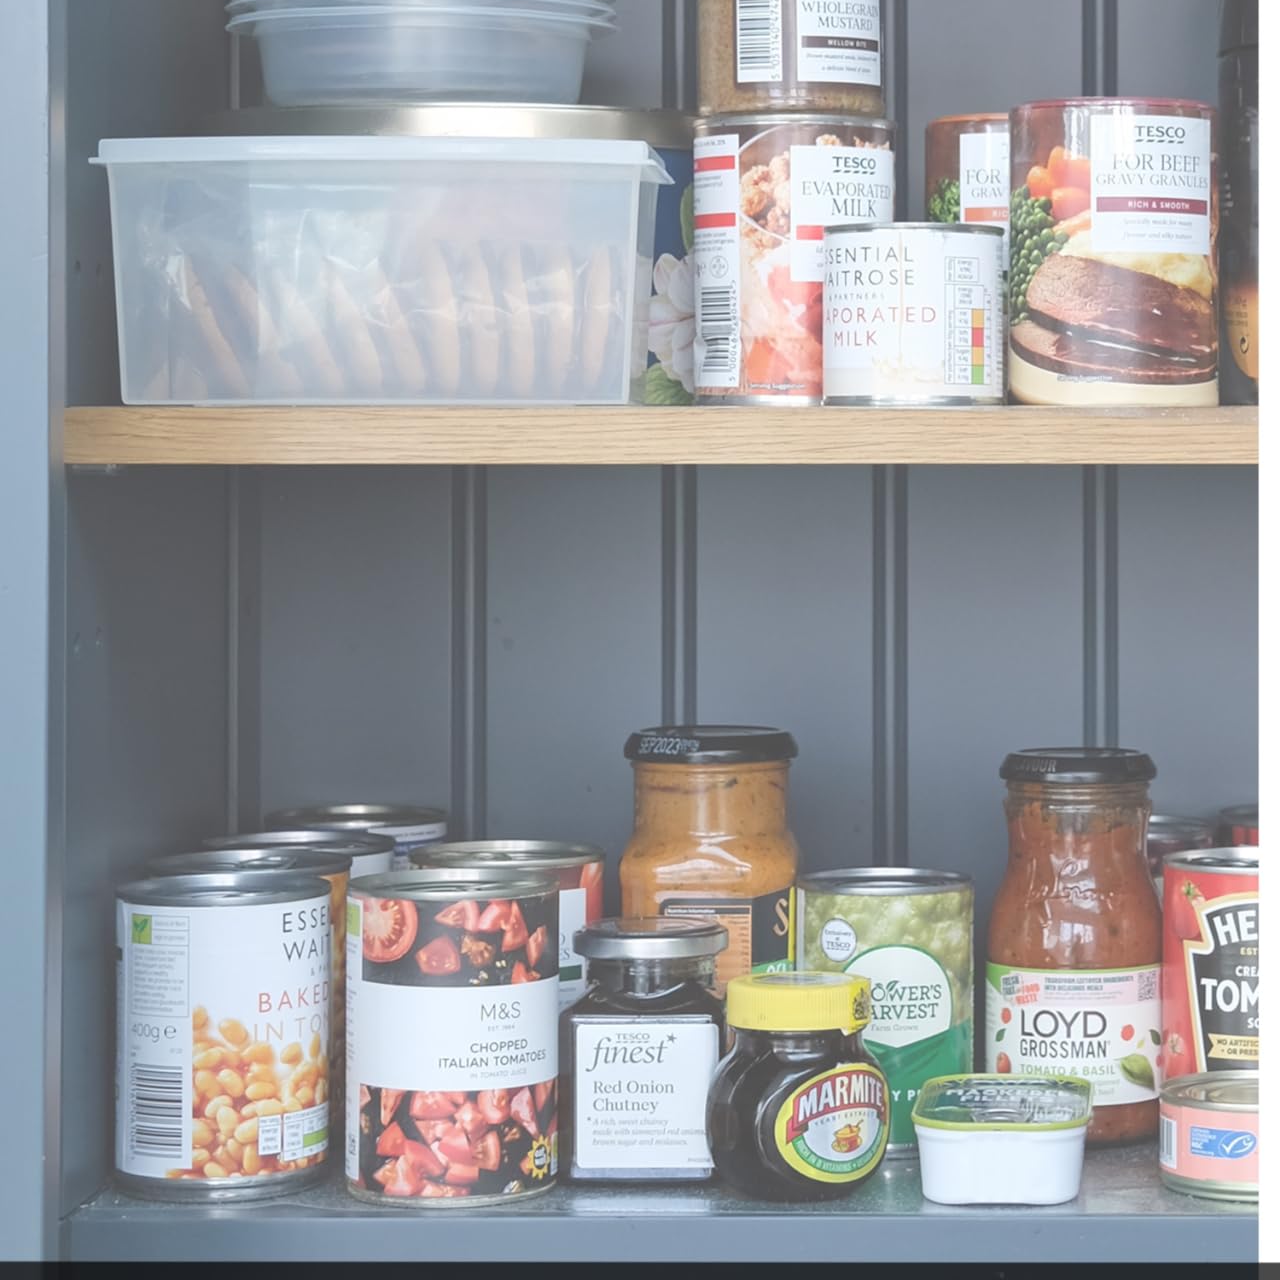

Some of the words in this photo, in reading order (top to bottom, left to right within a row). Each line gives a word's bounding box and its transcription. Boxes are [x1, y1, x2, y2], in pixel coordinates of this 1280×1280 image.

[817, 16, 874, 32] MUSTARD
[1134, 124, 1186, 139] TESCO
[831, 155, 877, 170] TESCO
[1111, 153, 1154, 171] FOR
[1160, 153, 1202, 173] BEEF
[965, 168, 1002, 185] FOR
[1095, 172, 1147, 186] GRAVY
[1149, 174, 1209, 189] GRANULES
[801, 180, 892, 200] EVAPORATED
[831, 197, 878, 218] MILK
[1127, 199, 1149, 209] RICH
[1151, 200, 1157, 209] &
[1159, 200, 1190, 210] SMOOTH
[833, 329, 879, 347] MILK
[826, 940, 851, 948] TESCO
[480, 1000, 521, 1021] M&S
[254, 1021, 284, 1042] IN
[870, 1023, 892, 1032] Farm
[893, 1023, 919, 1032] Grown
[1020, 1008, 1107, 1039] LOYD
[131, 1023, 160, 1043] 400g
[615, 1032, 651, 1040] TESCO
[469, 1038, 528, 1053] CHOPPED
[585, 1036, 668, 1072] finest
[1020, 1039, 1107, 1059] GROSSMAN
[438, 1056, 489, 1069] ITALIAN
[493, 1048, 546, 1066] TOMATOES
[1020, 1063, 1066, 1077] TOMATO
[1069, 1064, 1077, 1075] &
[1082, 1062, 1116, 1076] BASIL
[593, 1080, 622, 1095] Red
[626, 1079, 674, 1095] Onion
[592, 1097, 659, 1115] Chutney
[798, 1073, 883, 1123] MARMITE
